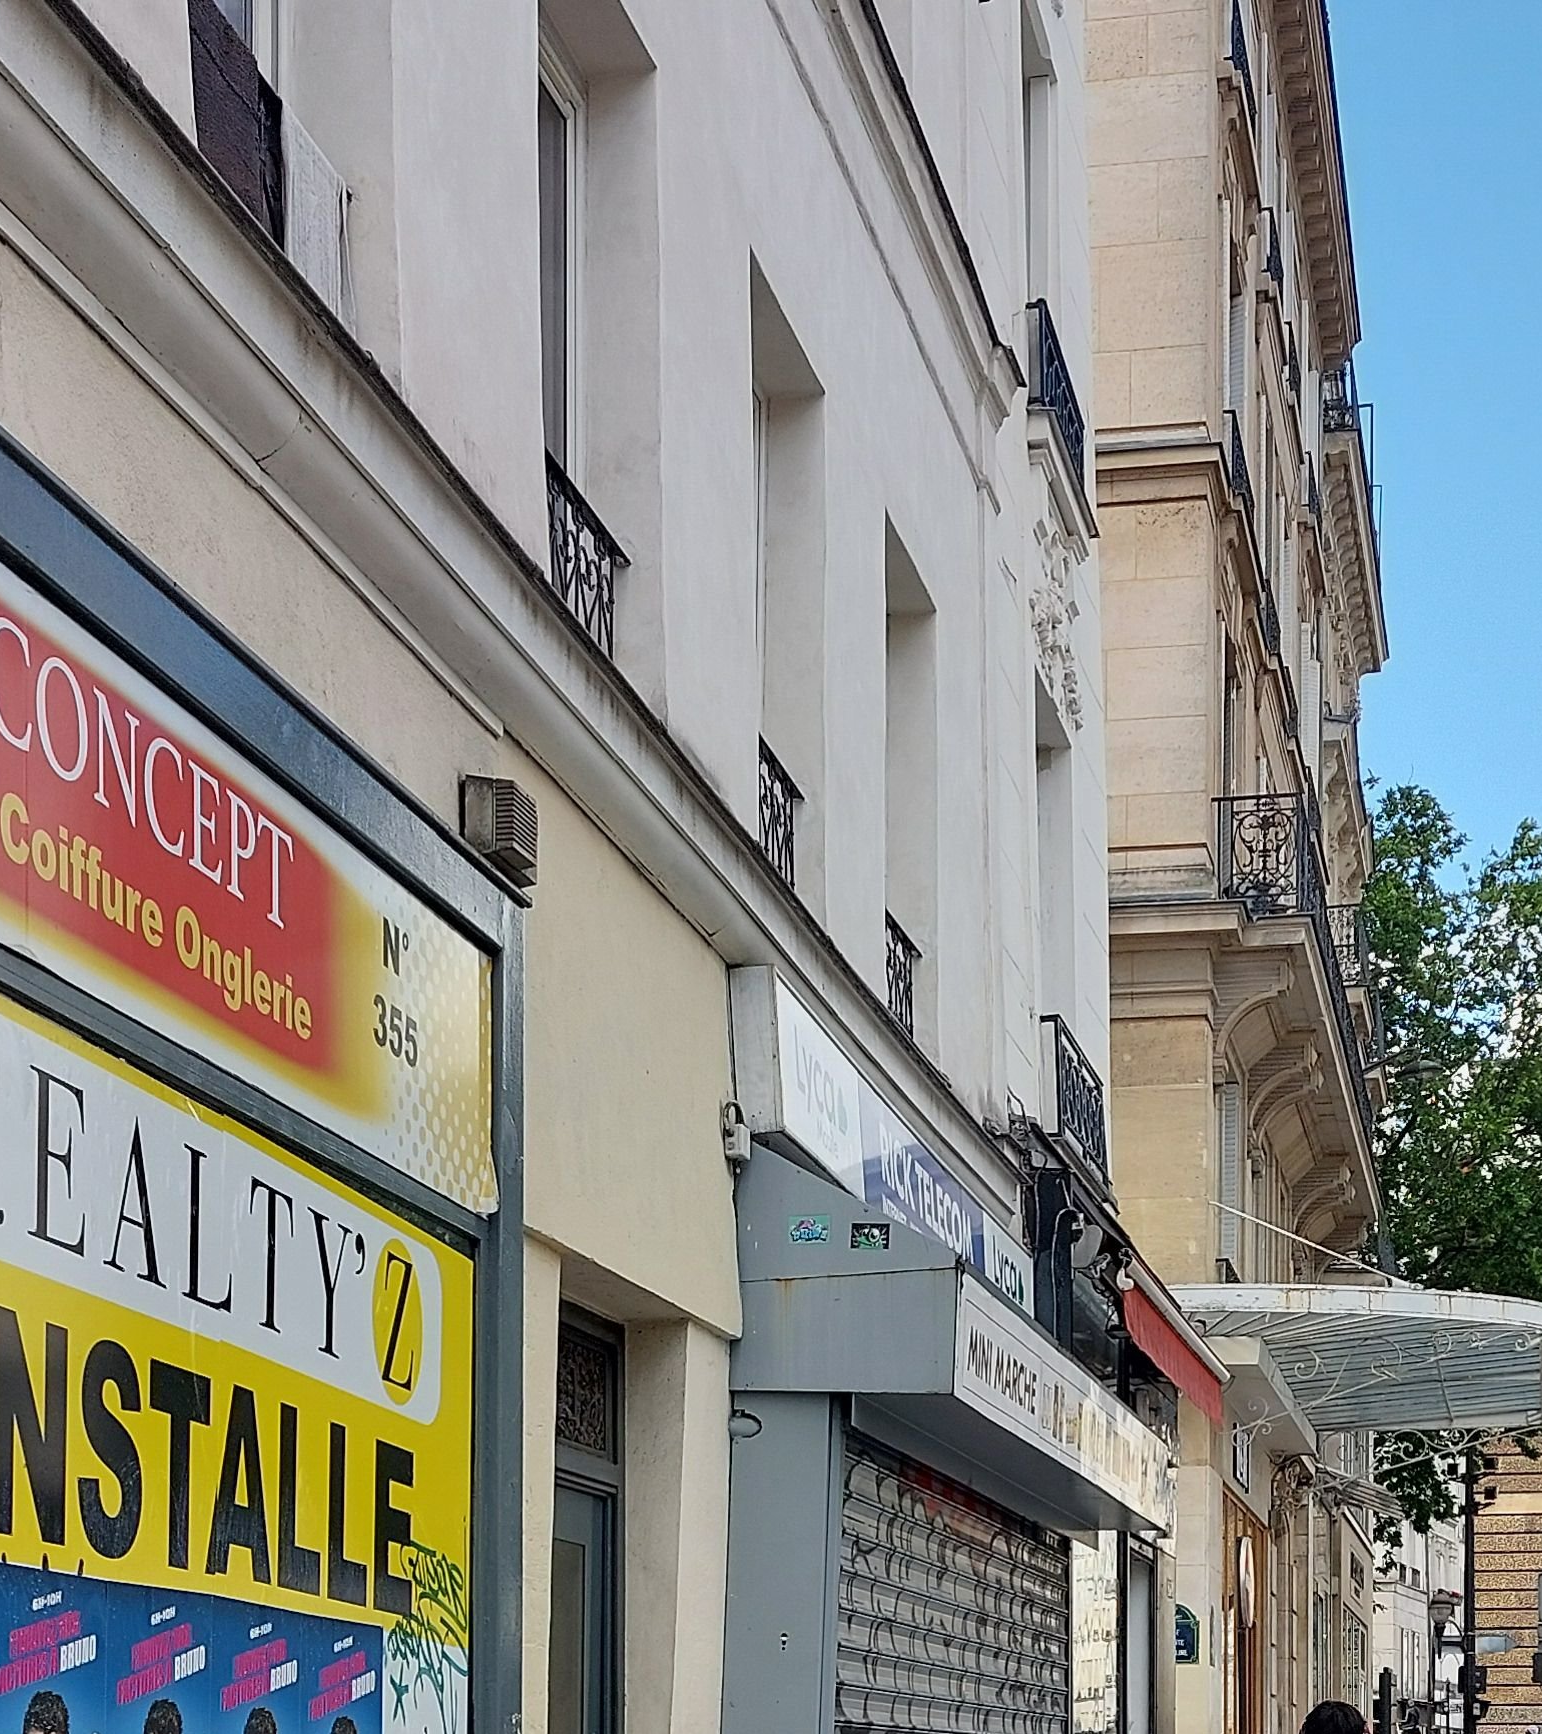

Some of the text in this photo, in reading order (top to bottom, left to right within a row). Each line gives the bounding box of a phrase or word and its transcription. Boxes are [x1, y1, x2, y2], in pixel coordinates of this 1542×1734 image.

[0, 790, 164, 949] Coiffure
[173, 905, 313, 1041] Onglerie
[380, 913, 411, 977] N°
[371, 991, 420, 1069] 355
[878, 1122, 975, 1264] RICK TELECOM
[992, 1235, 1018, 1303] Lyca
[966, 1325, 1037, 1415] MINI MARCHE
[59, 1633, 98, 1673] BRUNO
[174, 1645, 207, 1683] BRUNO
[270, 1659, 299, 1692] BRUNO
[351, 1669, 377, 1702] BRUNO
